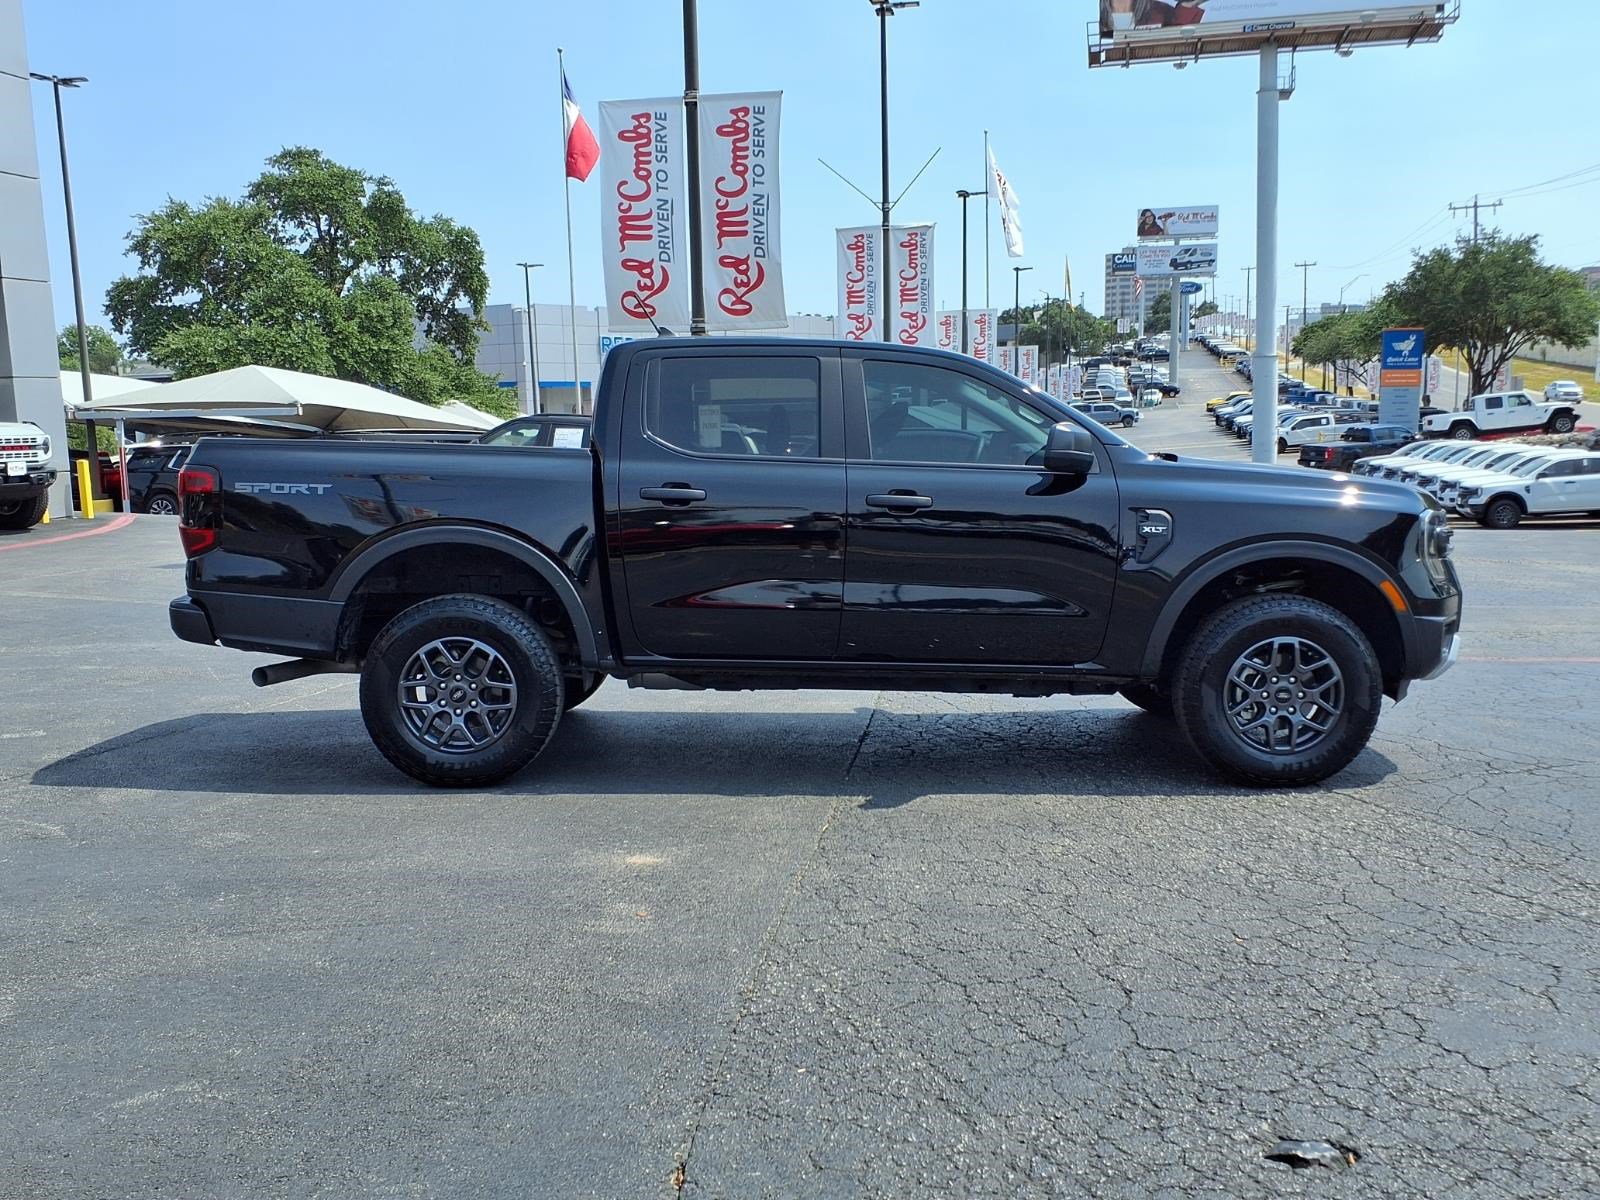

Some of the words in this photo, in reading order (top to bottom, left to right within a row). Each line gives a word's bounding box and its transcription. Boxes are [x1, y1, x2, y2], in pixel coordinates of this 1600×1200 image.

[654, 112, 668, 164] SERVE
[752, 106, 765, 158] SERVE
[617, 112, 653, 252] McCombs
[656, 169, 668, 192] TO
[715, 106, 750, 250] McCombs
[752, 164, 765, 187] TO
[657, 198, 671, 263] DRIVEN
[752, 193, 766, 258] DRIVEN
[621, 258, 670, 319] Red
[718, 254, 764, 316] Red
[846, 234, 865, 310] McCombs
[866, 264, 874, 277] TO
[899, 232, 918, 308] McCombs
[920, 262, 927, 274] TO
[602, 337, 633, 352] RE
[846, 313, 872, 340] Red
[899, 312, 926, 344] Red
[939, 315, 952, 347] Combs
[234, 482, 333, 494] SPORT
